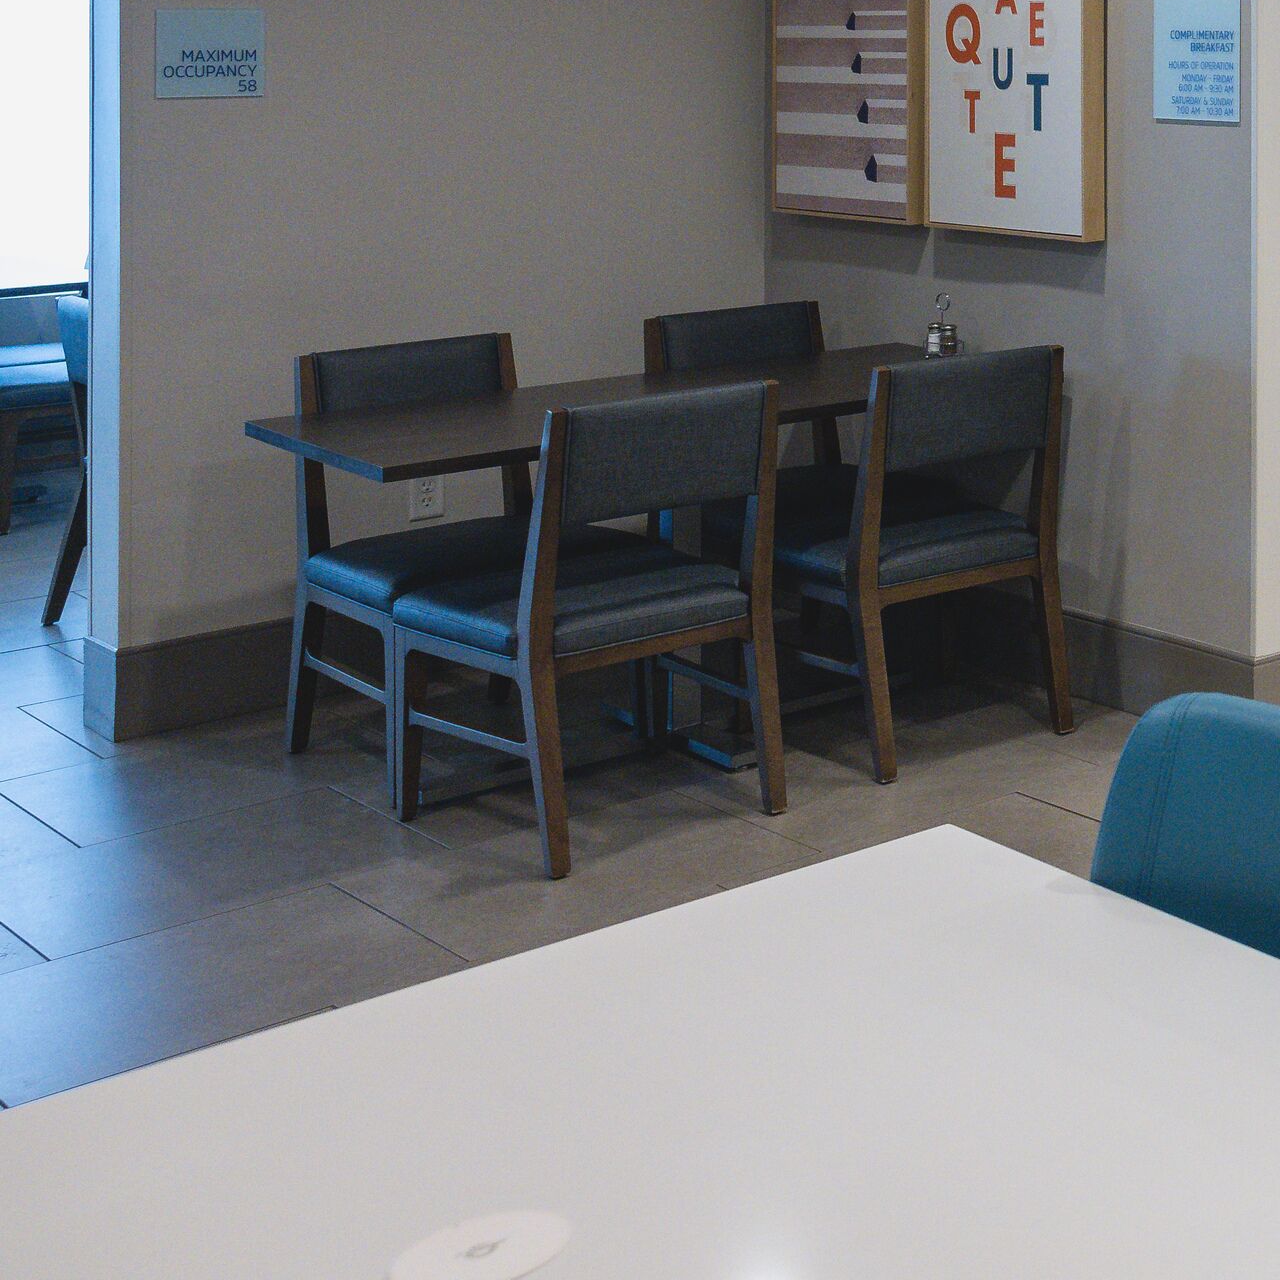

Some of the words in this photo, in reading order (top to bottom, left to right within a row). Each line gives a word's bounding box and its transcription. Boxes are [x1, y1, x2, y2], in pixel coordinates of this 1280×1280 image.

[1169, 29, 1235, 40] COMPLIMENTARY
[1190, 42, 1234, 53] BREAKFAST
[181, 49, 257, 62] MAXIMUM
[163, 64, 258, 78] OCCUPANCY
[1168, 60, 1189, 70] HOURS
[1190, 60, 1199, 70] OF
[1200, 61, 1234, 71] OPERATION
[1181, 73, 1207, 83] MONDAY
[1213, 74, 1234, 84] FRIDAY
[238, 79, 257, 92] 58
[1171, 95, 1201, 105] SATURDAY
[1209, 97, 1233, 107] SUNDAY
